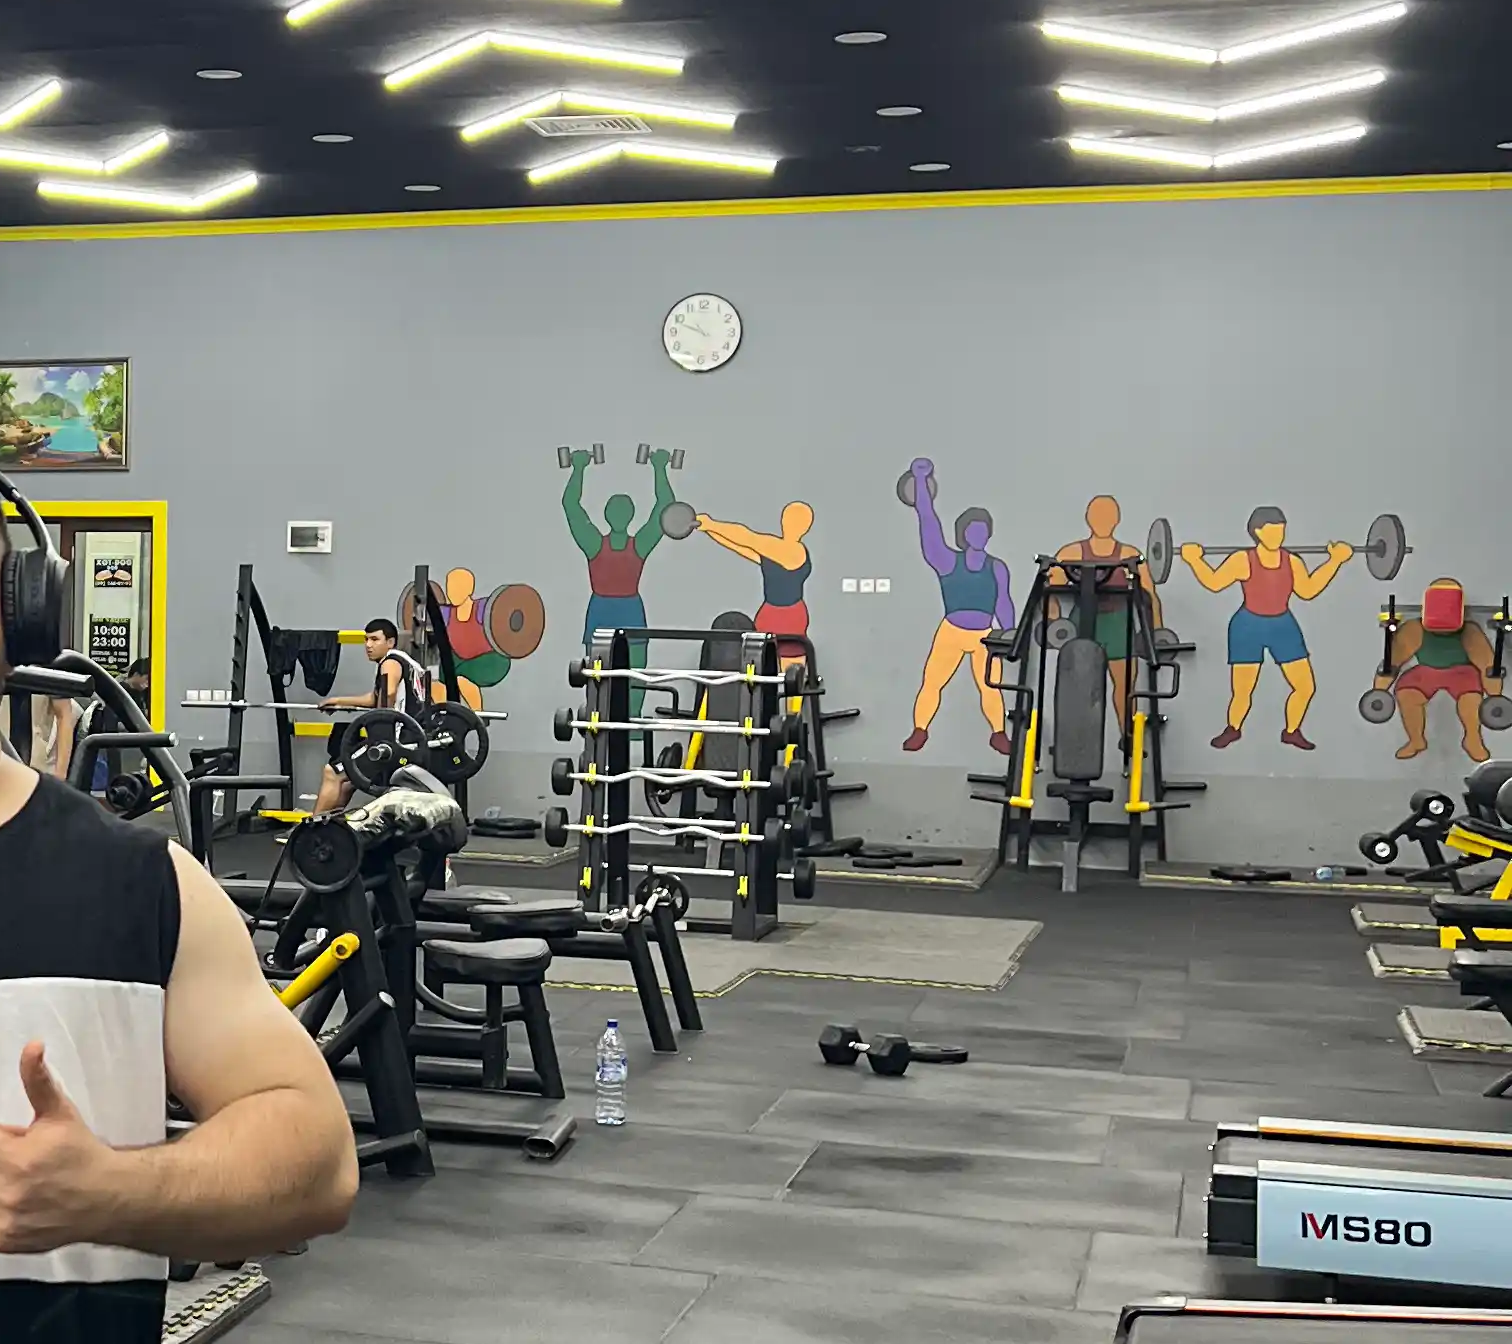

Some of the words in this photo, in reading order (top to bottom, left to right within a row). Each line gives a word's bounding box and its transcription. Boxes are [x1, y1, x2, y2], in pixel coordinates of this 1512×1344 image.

[93, 625, 127, 636] 10:00
[92, 636, 126, 647] 23:00
[1301, 1212, 1432, 1247] MS80
